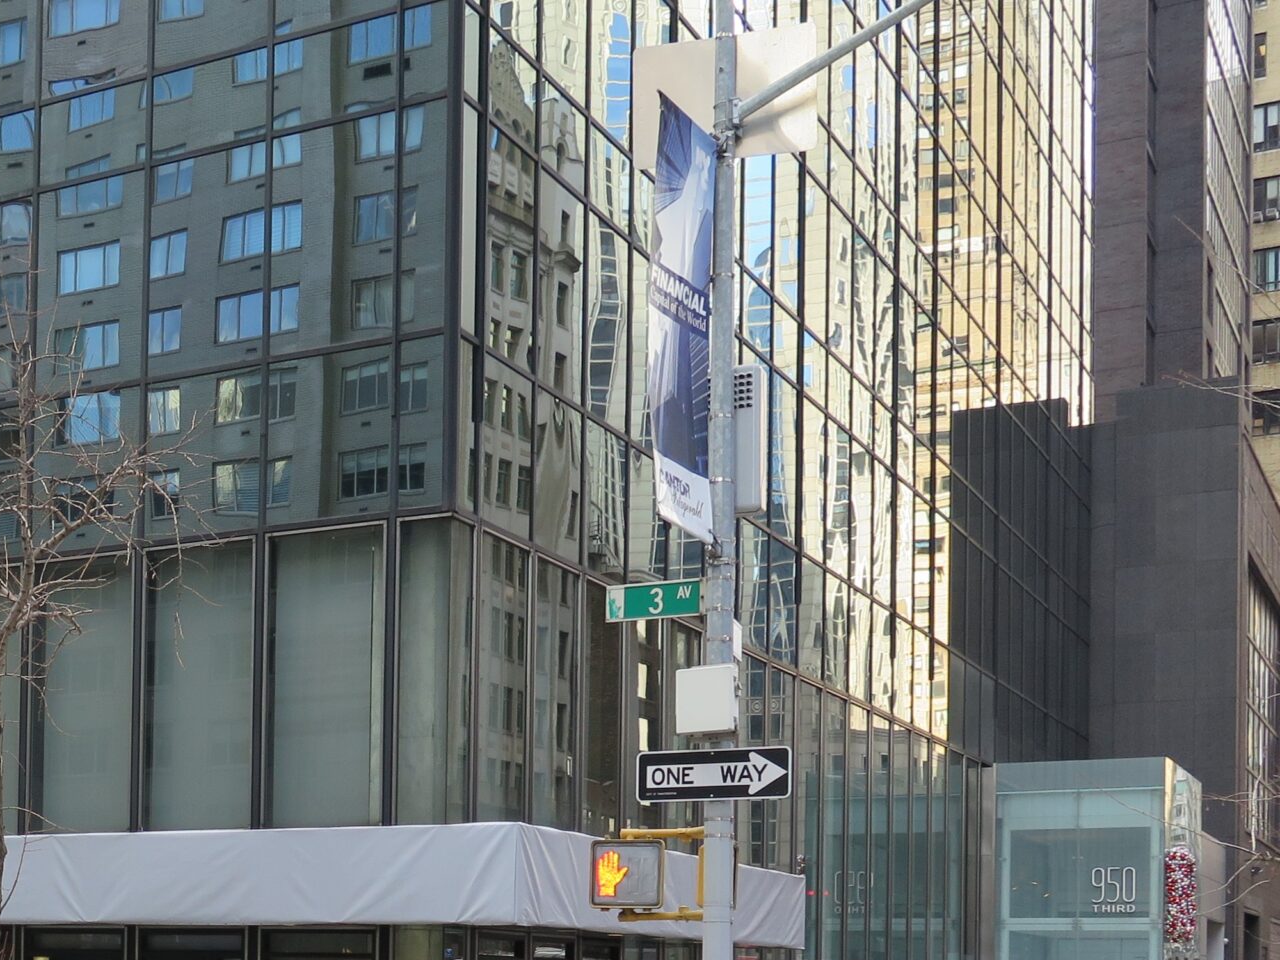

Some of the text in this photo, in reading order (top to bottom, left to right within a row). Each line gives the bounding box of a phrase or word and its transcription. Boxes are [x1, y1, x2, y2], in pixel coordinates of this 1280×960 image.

[651, 263, 707, 317] FINANCIAL
[687, 310, 707, 332] World
[648, 585, 692, 615] 3 AV
[651, 764, 768, 786] ONE WAY
[1091, 866, 1136, 903] 950
[1091, 904, 1136, 913] THIRD
